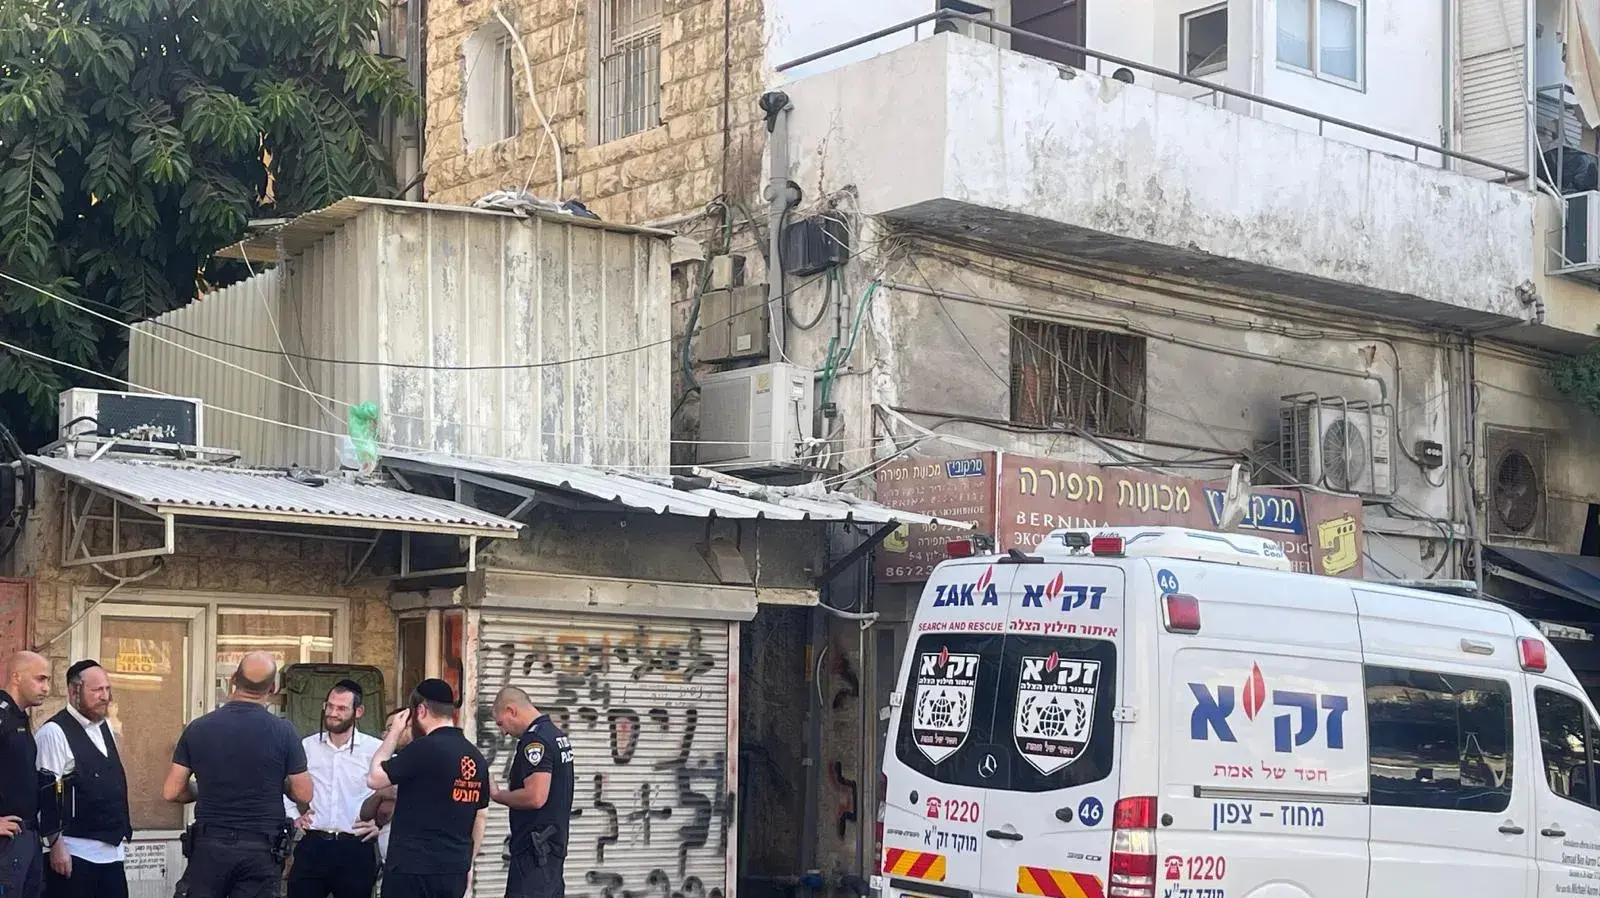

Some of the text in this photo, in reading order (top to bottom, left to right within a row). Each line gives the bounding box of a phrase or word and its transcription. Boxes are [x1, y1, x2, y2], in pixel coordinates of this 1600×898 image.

[880, 468, 909, 482] תפירה
[913, 464, 941, 479] מכונות
[1020, 467, 1103, 504] תפירה
[1118, 479, 1191, 513] מכונות
[1161, 575, 1177, 590] 46
[918, 622, 1004, 631] SEARCH AND RESCUE
[1009, 619, 1118, 637] איתור חילוץ הצלה
[1020, 682, 1095, 695] איתור חילוץ הצלה
[1213, 760, 1328, 781] חסד של אמת
[453, 788, 480, 803] חובש
[944, 800, 980, 823] 1220
[1080, 803, 1100, 819] 46
[1213, 802, 1252, 830] צפון
[1281, 805, 1324, 826] מחוז
[952, 833, 977, 852] מוקד
[1187, 855, 1226, 880] 1220
